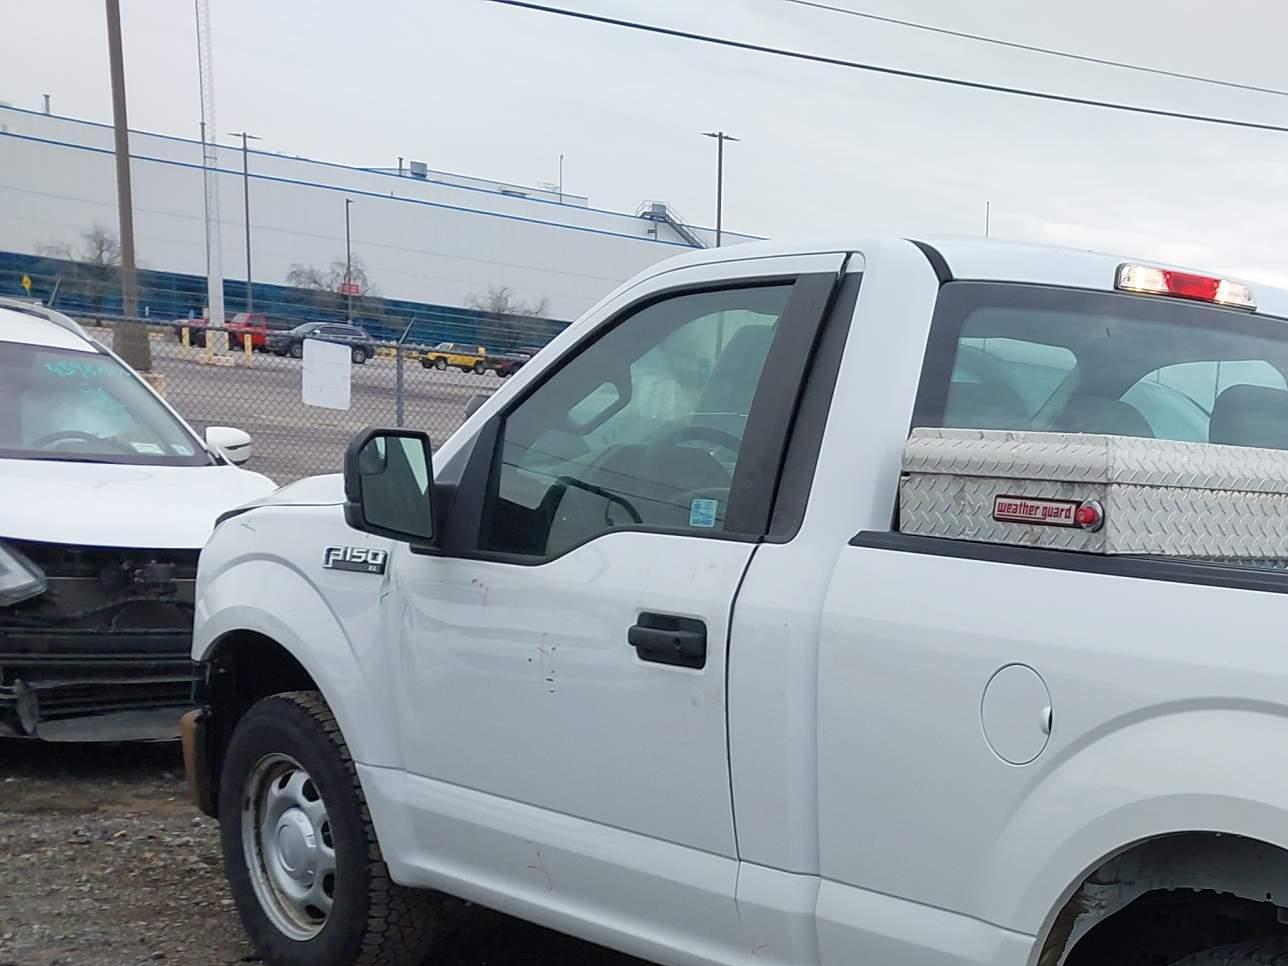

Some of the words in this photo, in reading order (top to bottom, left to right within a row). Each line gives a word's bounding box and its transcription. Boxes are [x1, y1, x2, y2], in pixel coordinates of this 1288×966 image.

[997, 501, 1039, 517] weather
[1041, 505, 1072, 521] guard
[322, 545, 387, 568] F150
